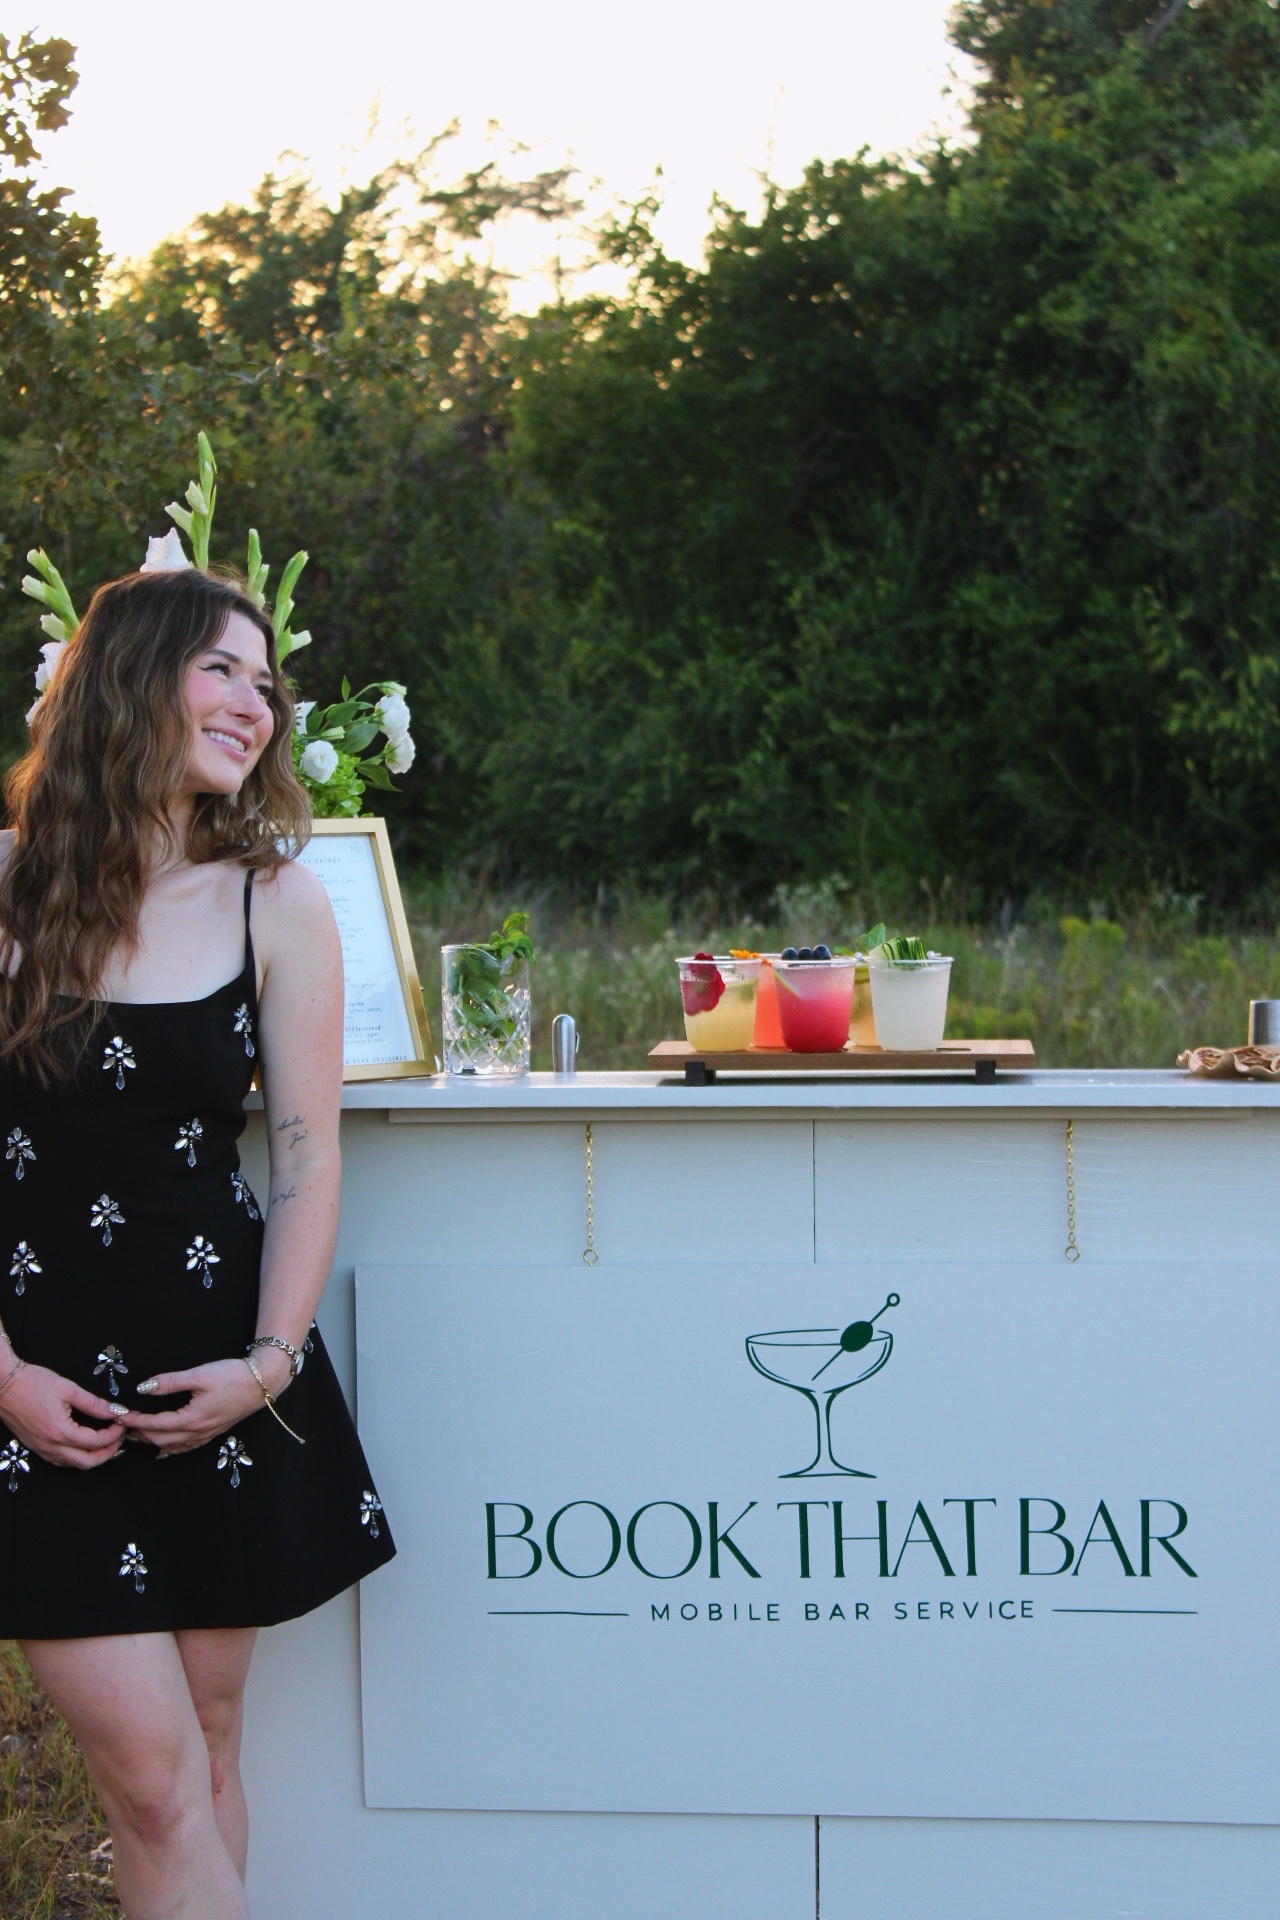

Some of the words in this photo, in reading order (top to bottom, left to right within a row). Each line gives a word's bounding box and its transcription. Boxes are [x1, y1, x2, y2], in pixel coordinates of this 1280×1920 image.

[484, 1500, 762, 1579] BOOK
[776, 1498, 997, 1578] THAT
[1018, 1497, 1199, 1578] BAR
[650, 1603, 781, 1621] MOBILE
[804, 1602, 871, 1620] BAR
[894, 1600, 1035, 1620] SERVICE
